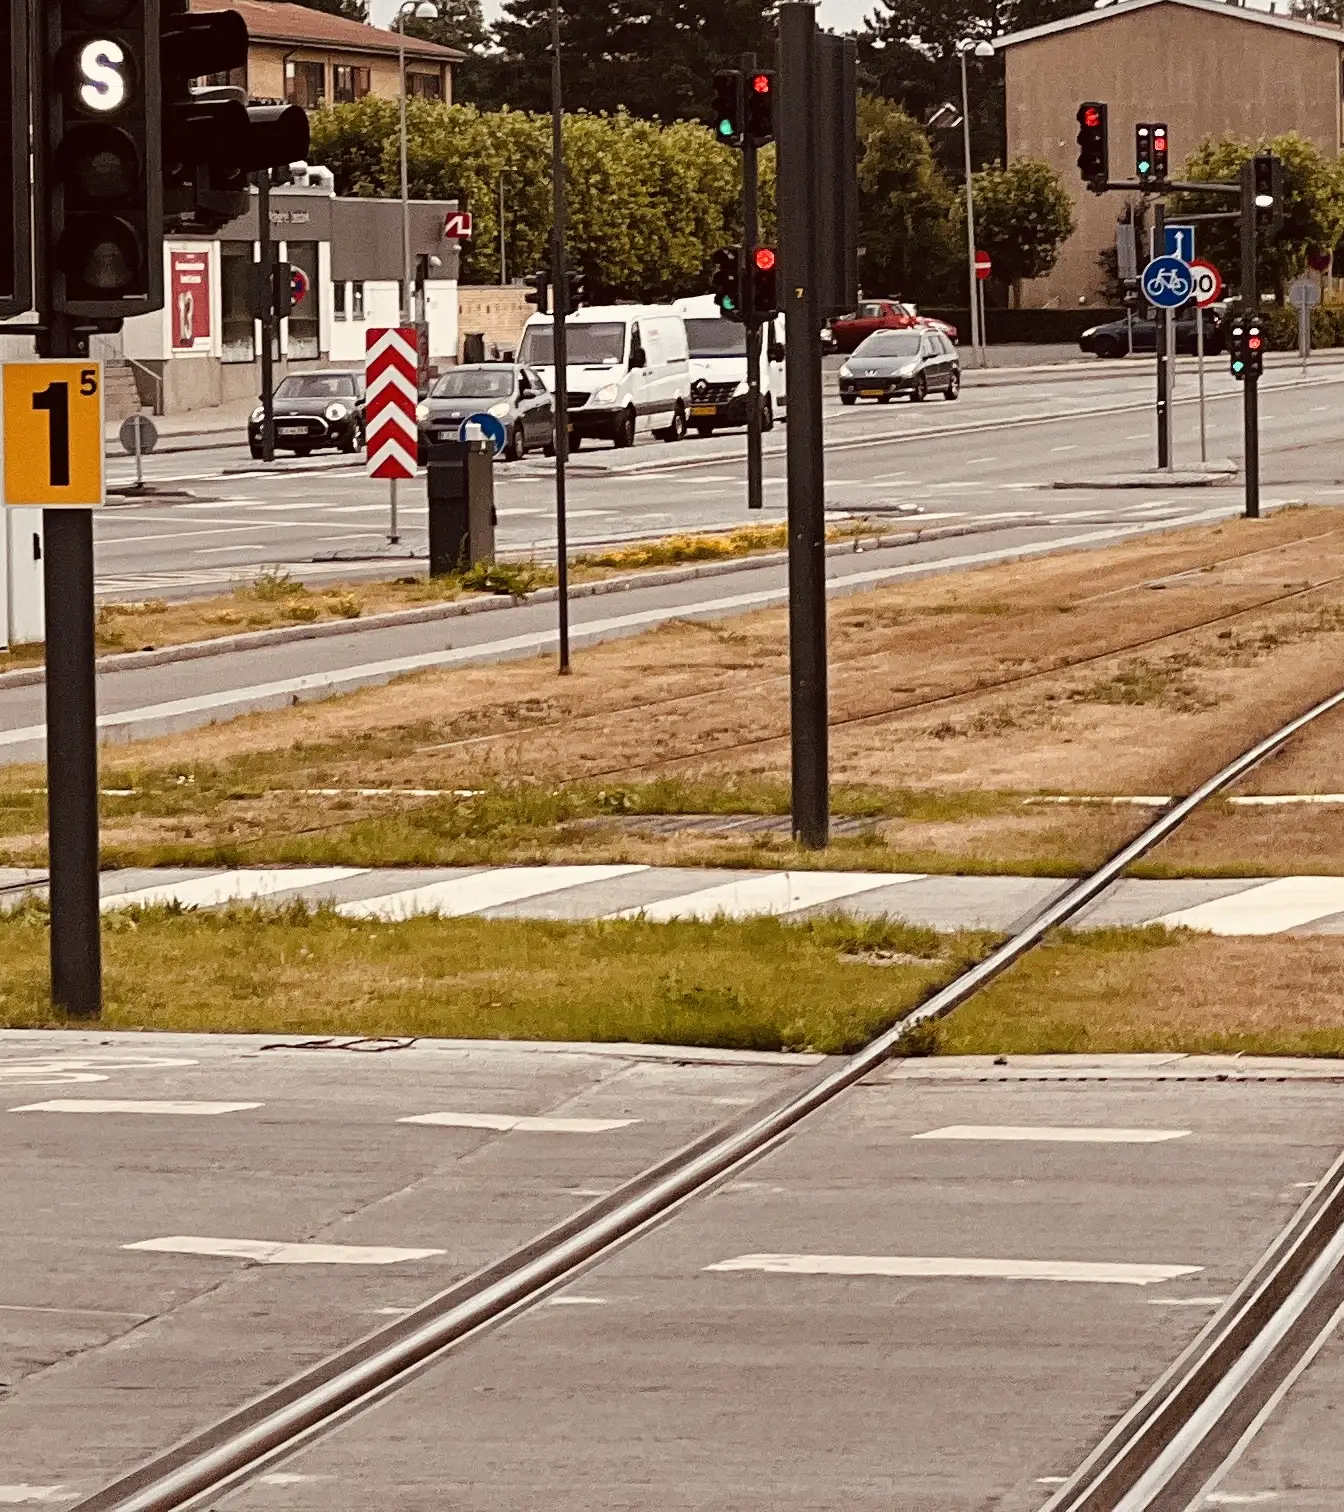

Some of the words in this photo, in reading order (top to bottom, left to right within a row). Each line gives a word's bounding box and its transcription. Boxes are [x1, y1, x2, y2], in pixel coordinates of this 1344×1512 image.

[80, 39, 124, 111] S
[32, 381, 70, 486] 1
[80, 369, 98, 396] 5
